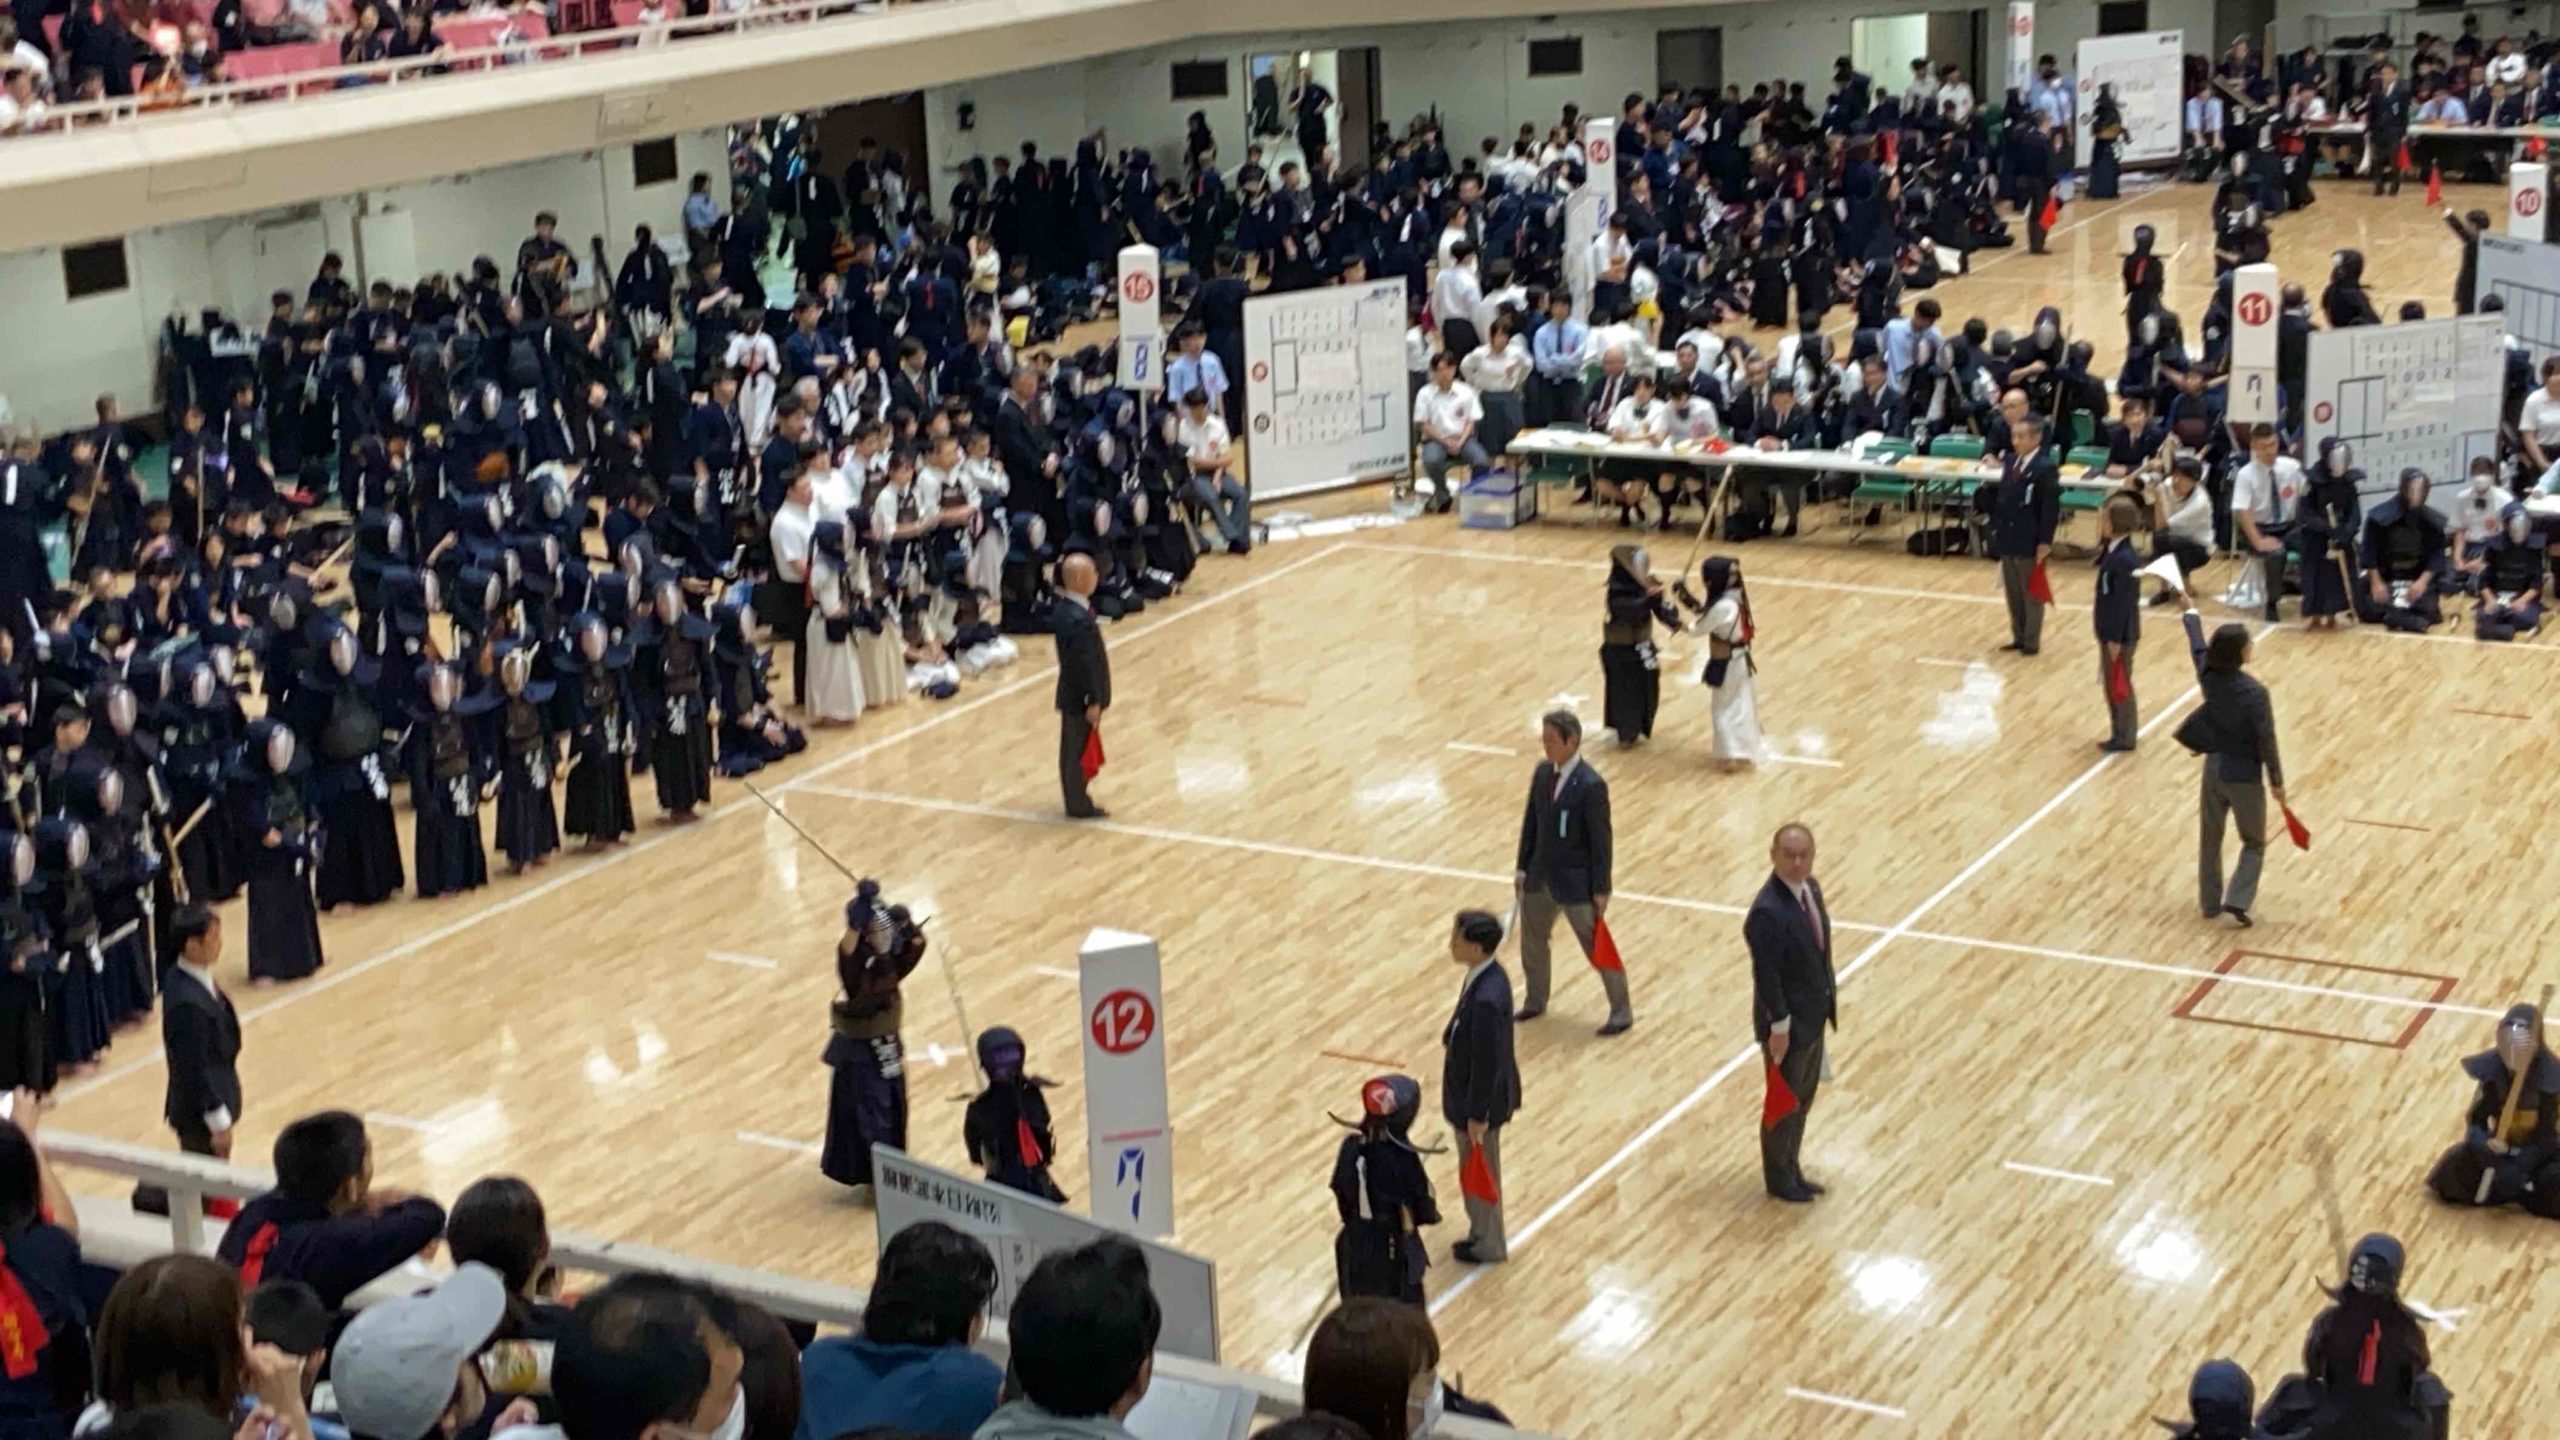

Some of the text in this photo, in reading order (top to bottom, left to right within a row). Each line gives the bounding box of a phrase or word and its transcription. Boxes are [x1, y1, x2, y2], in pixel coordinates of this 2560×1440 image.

[2518, 190, 2540, 213] 10
[2242, 296, 2268, 324] 11
[1095, 996, 1147, 1048] 12
